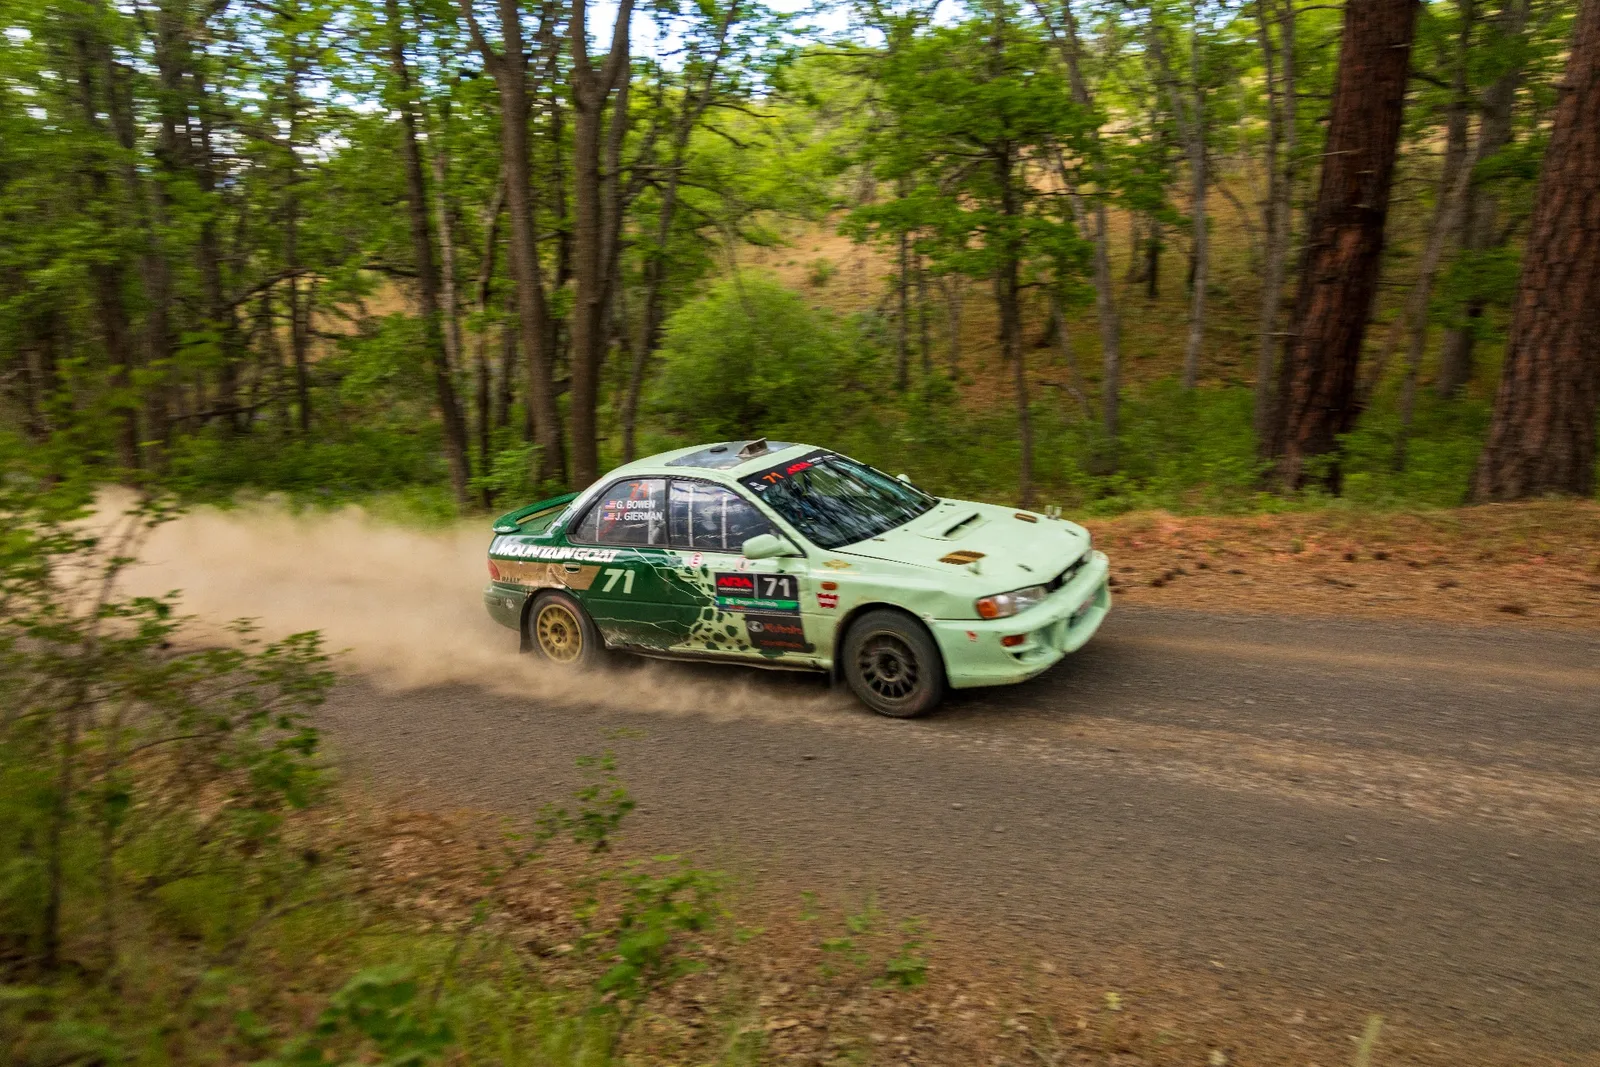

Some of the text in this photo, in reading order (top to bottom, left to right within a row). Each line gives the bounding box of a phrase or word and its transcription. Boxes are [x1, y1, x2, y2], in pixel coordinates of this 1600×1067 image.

[762, 472, 785, 484] 71
[629, 483, 648, 499] 71
[616, 500, 656, 509] G. BOWEN
[615, 512, 622, 521] J.
[602, 568, 635, 594] 71
[717, 576, 754, 588] ARA
[763, 577, 791, 597] 71
